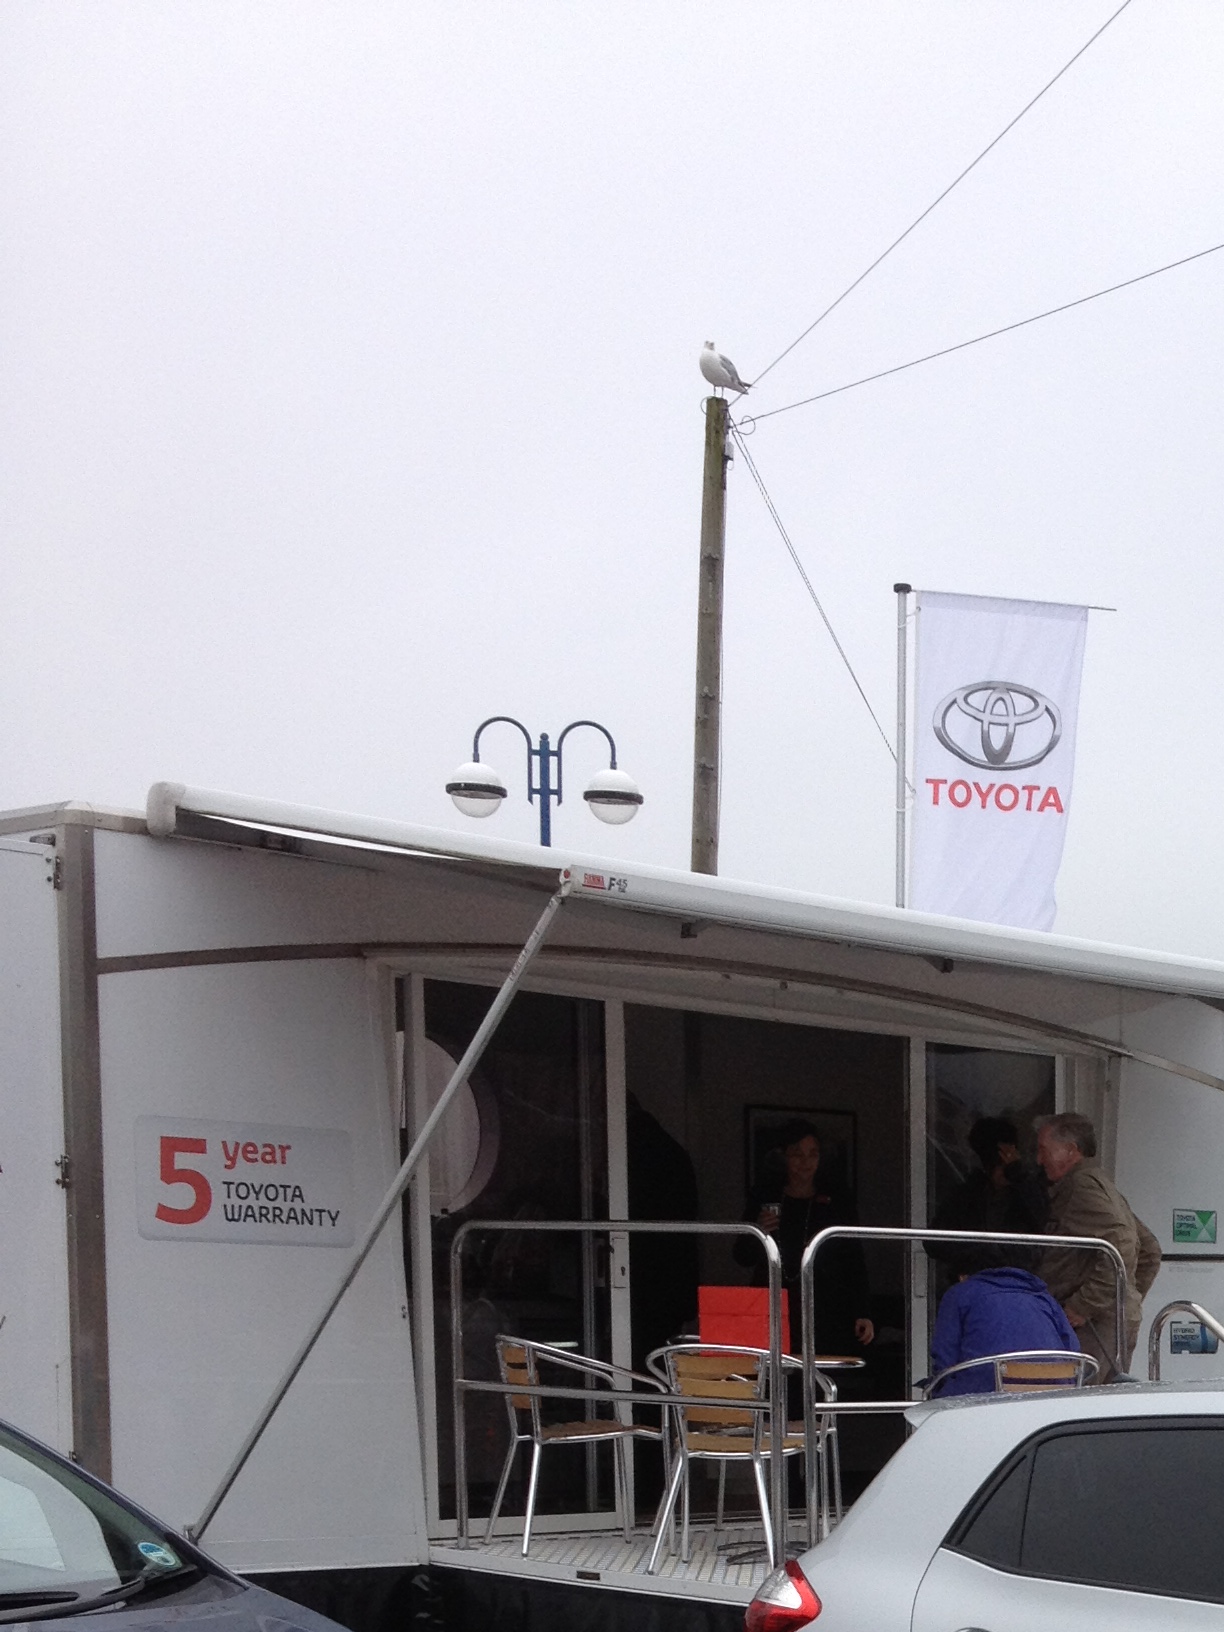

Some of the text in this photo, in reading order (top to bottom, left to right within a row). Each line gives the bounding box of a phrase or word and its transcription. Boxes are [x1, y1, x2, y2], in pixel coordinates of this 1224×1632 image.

[925, 778, 1064, 814] TOYOTA
[221, 1140, 292, 1170] year
[155, 1136, 212, 1226] 5
[222, 1181, 305, 1203] TOYOTA
[223, 1204, 340, 1227] WARRANTY
